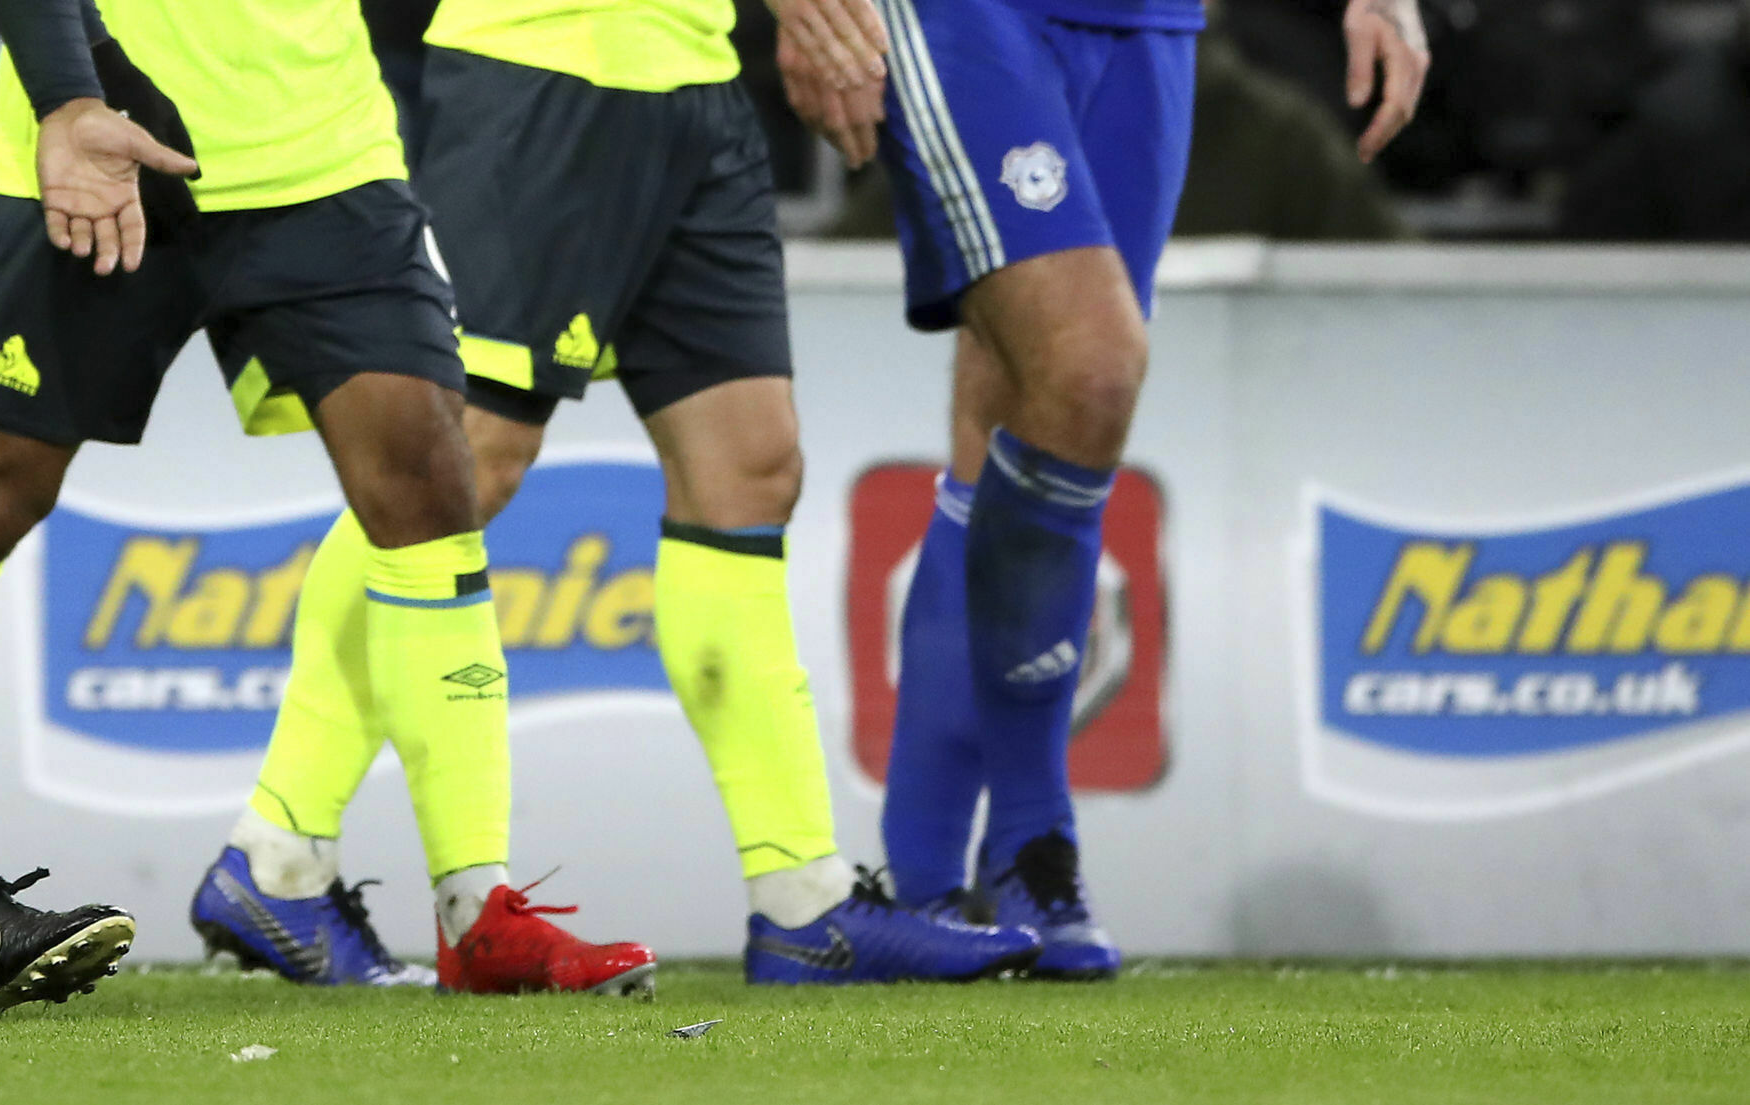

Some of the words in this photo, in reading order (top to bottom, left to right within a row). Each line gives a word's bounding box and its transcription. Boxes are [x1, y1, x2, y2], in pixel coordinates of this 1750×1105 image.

[1360, 539, 1750, 654] Natha
[67, 667, 290, 712] cars.c
[1344, 660, 1700, 716] cars.co.uk
